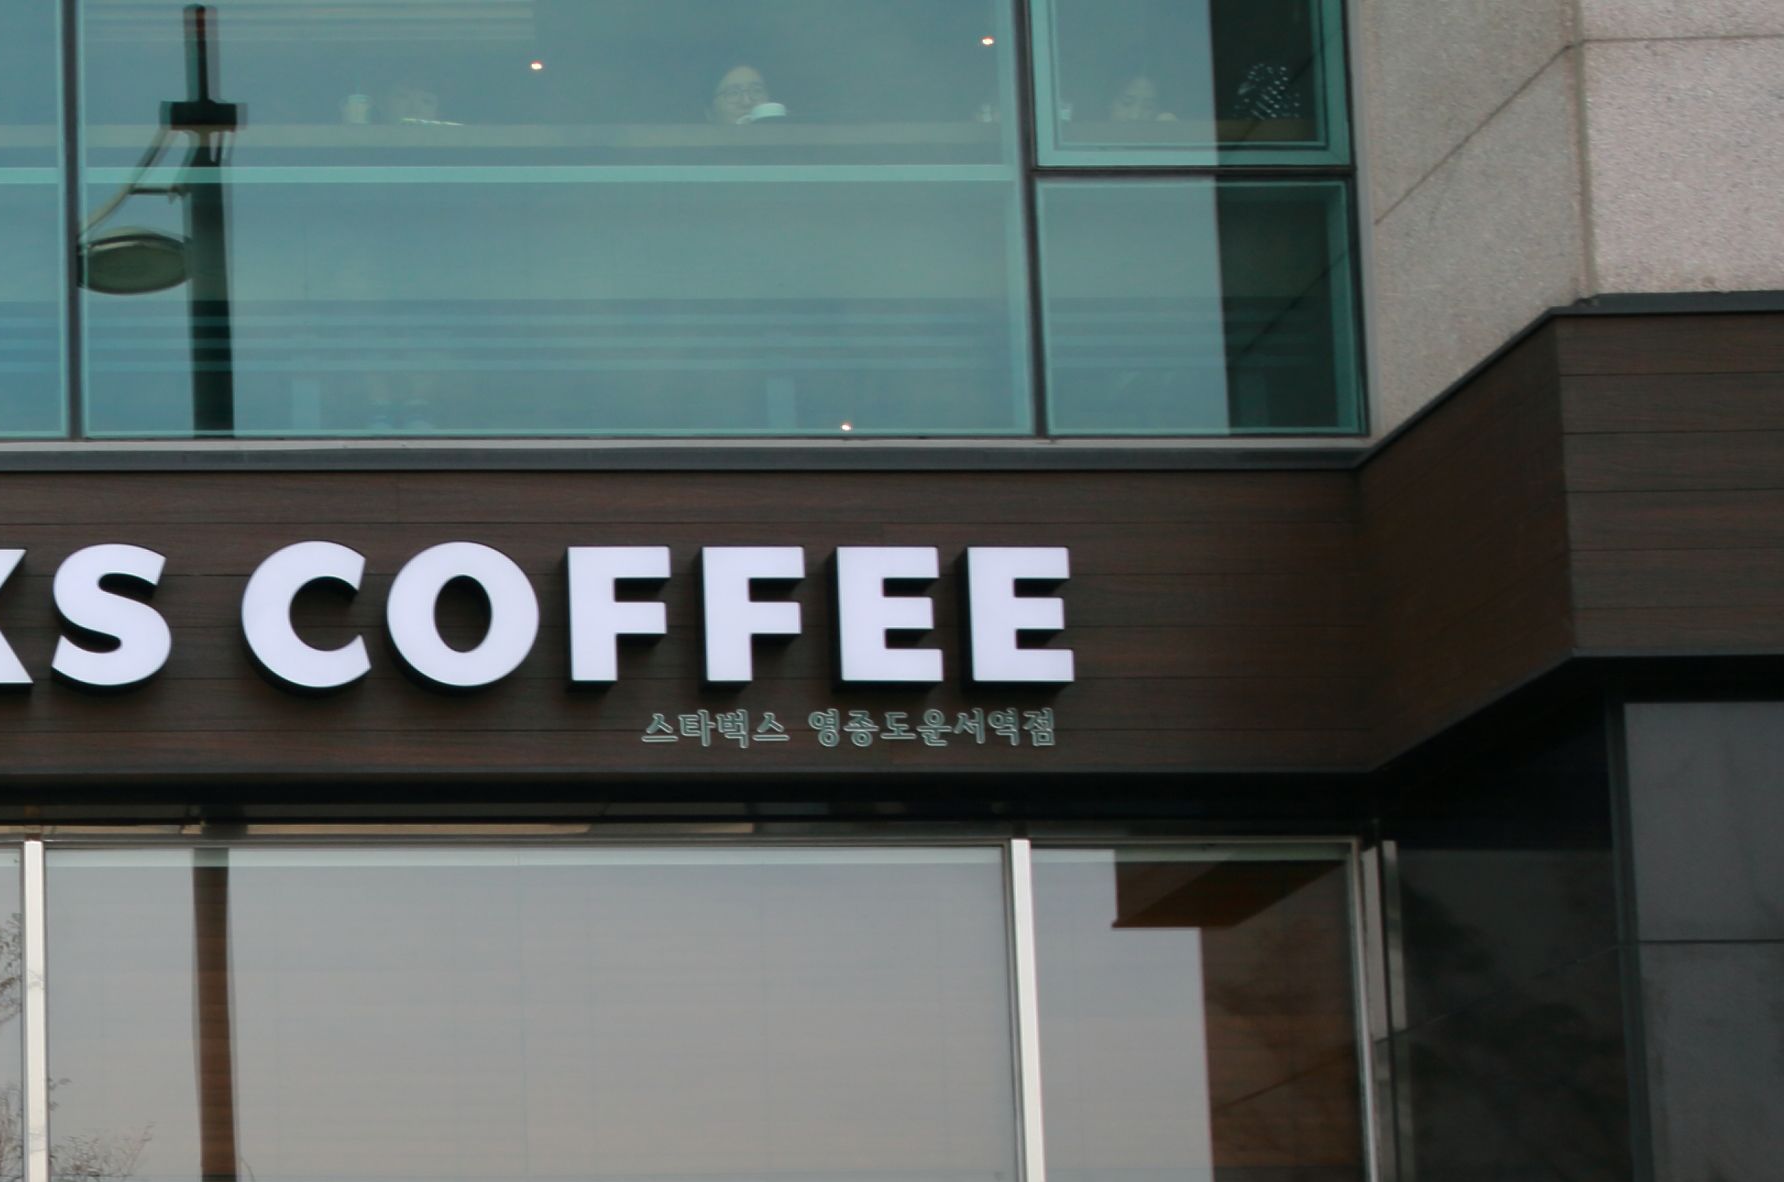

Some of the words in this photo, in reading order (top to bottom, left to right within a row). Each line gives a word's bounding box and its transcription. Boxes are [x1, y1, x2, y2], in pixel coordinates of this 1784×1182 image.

[241, 541, 1075, 689] COFFEE
[641, 708, 790, 748] 스타벅스
[808, 708, 1055, 748] 영종도운서역점
